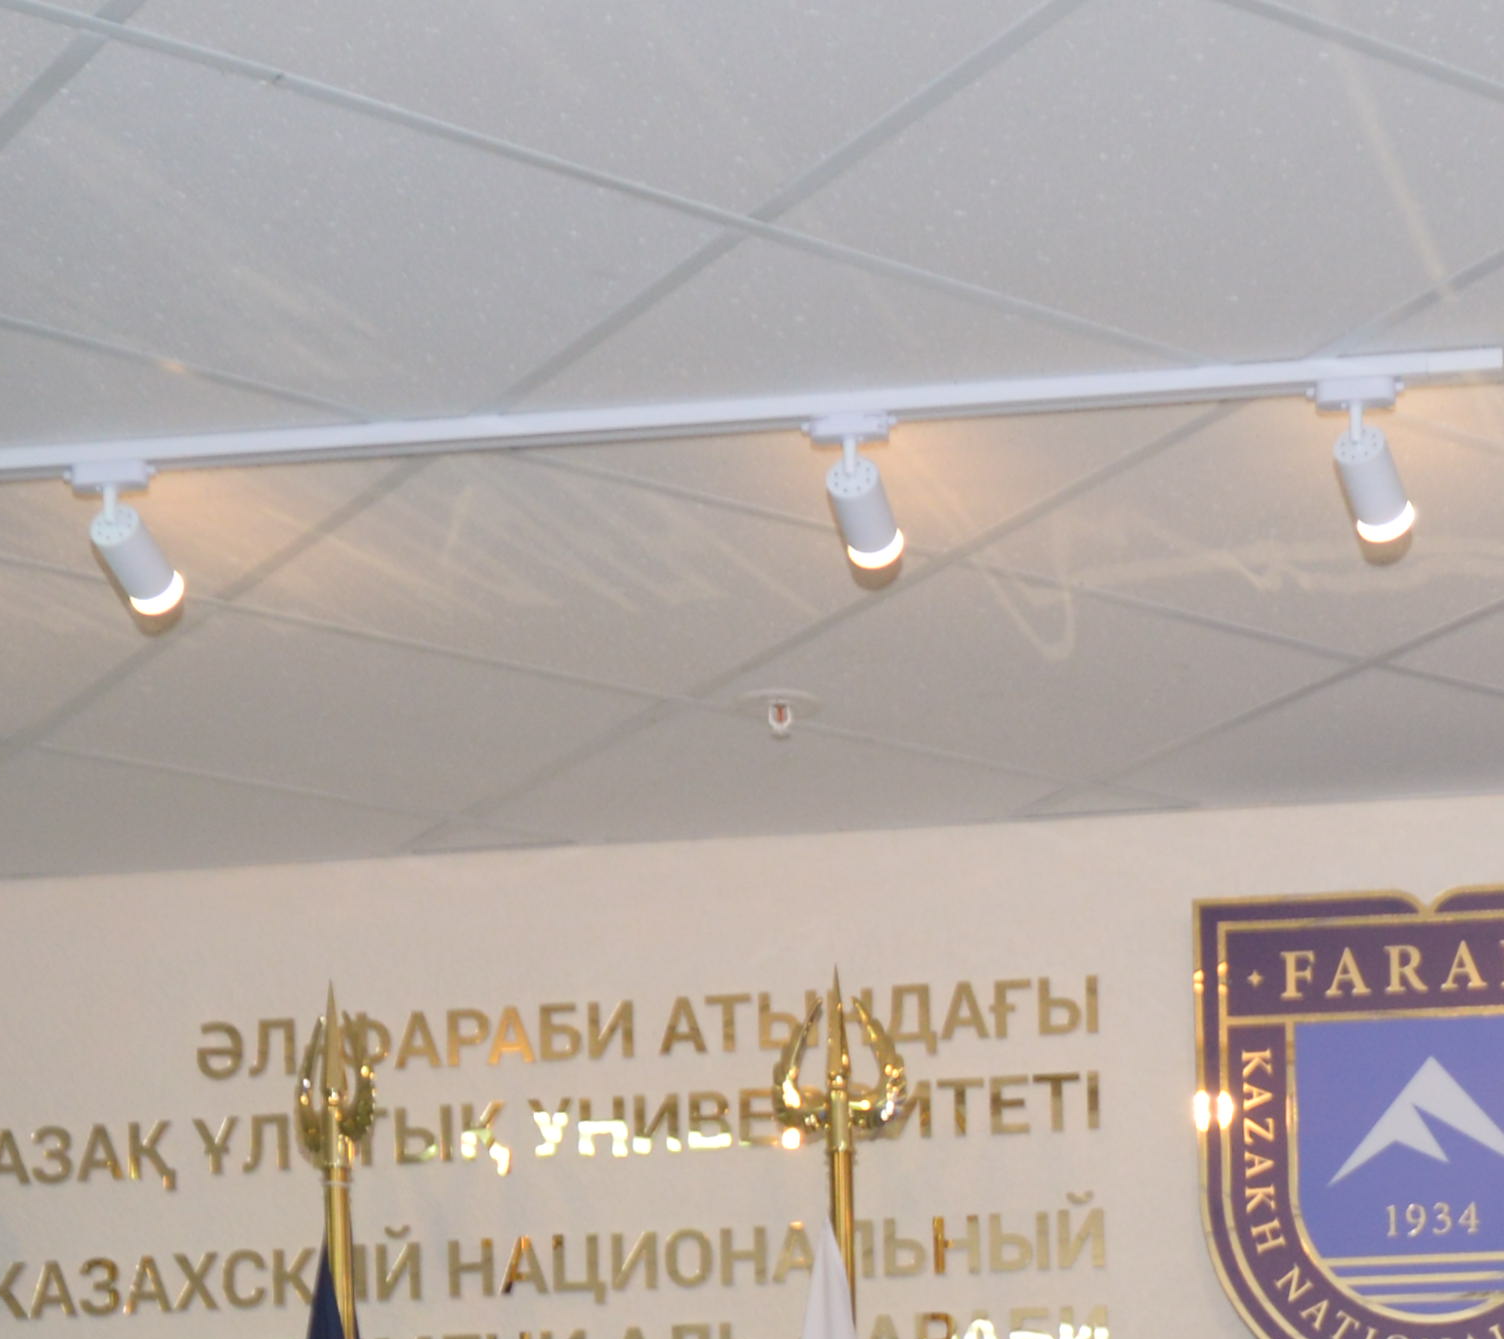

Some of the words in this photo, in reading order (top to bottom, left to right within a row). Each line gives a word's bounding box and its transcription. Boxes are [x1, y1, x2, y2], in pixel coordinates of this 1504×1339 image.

[529, 1070, 1101, 1158] УНИВЕИТЕТІ
[1240, 1048, 1286, 1255] KAZAKH
[1385, 1201, 1481, 1238] 1934
